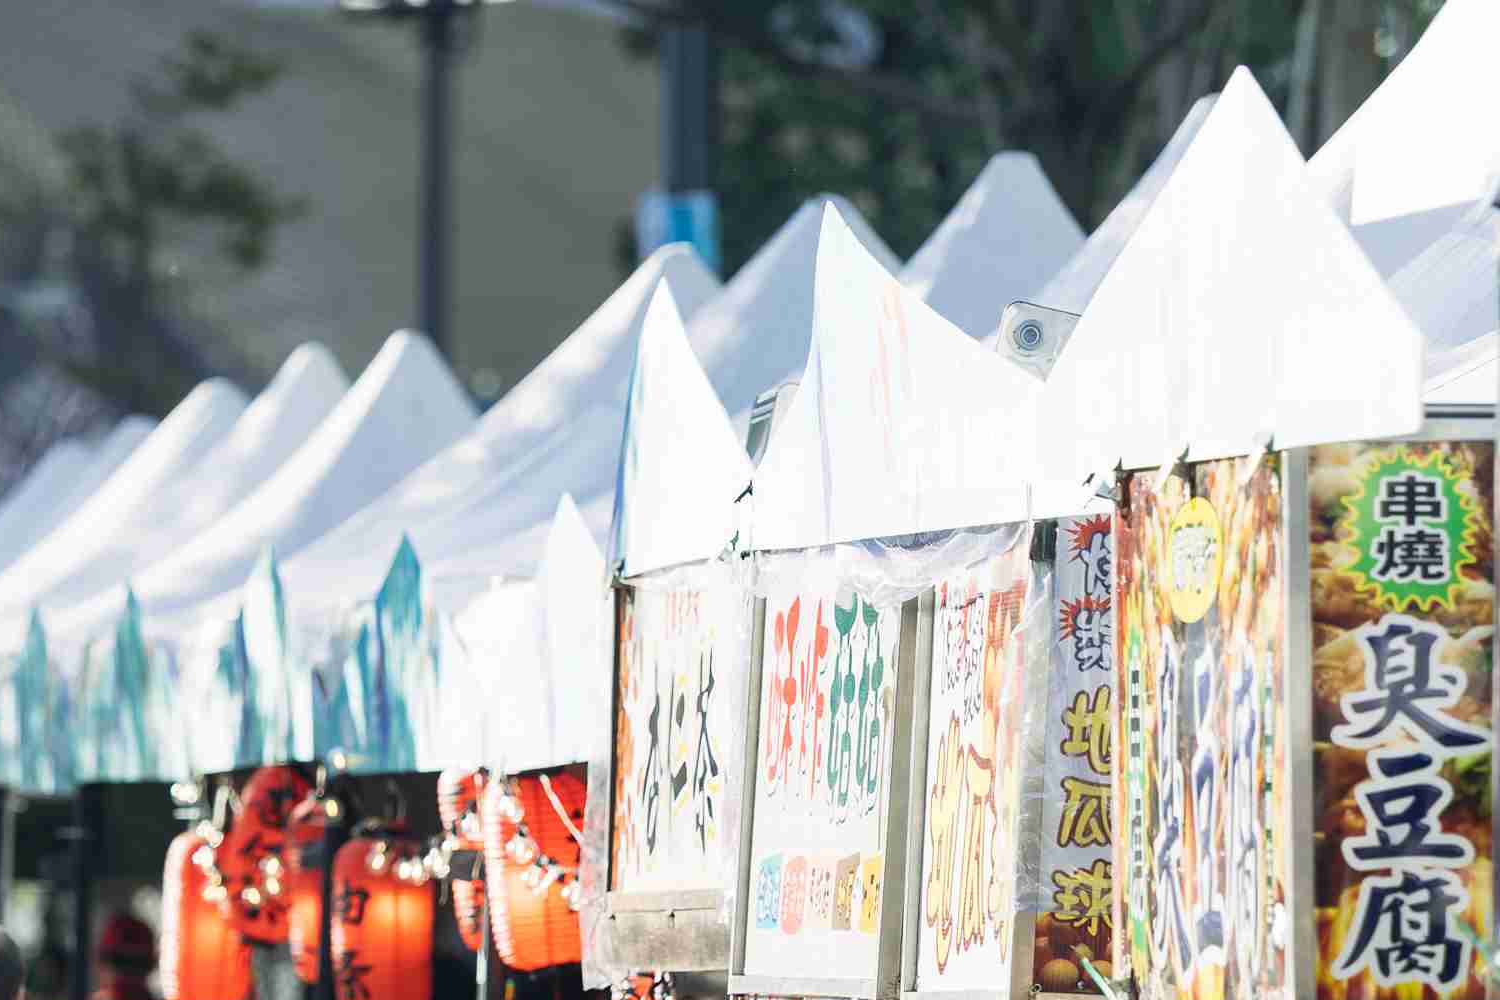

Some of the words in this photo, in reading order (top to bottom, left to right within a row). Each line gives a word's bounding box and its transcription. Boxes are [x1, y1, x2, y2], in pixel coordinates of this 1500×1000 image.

[1375, 474, 1446, 581] 串燒
[642, 648, 719, 856] 杏仁茶
[1342, 620, 1490, 989] 臭豆腐
